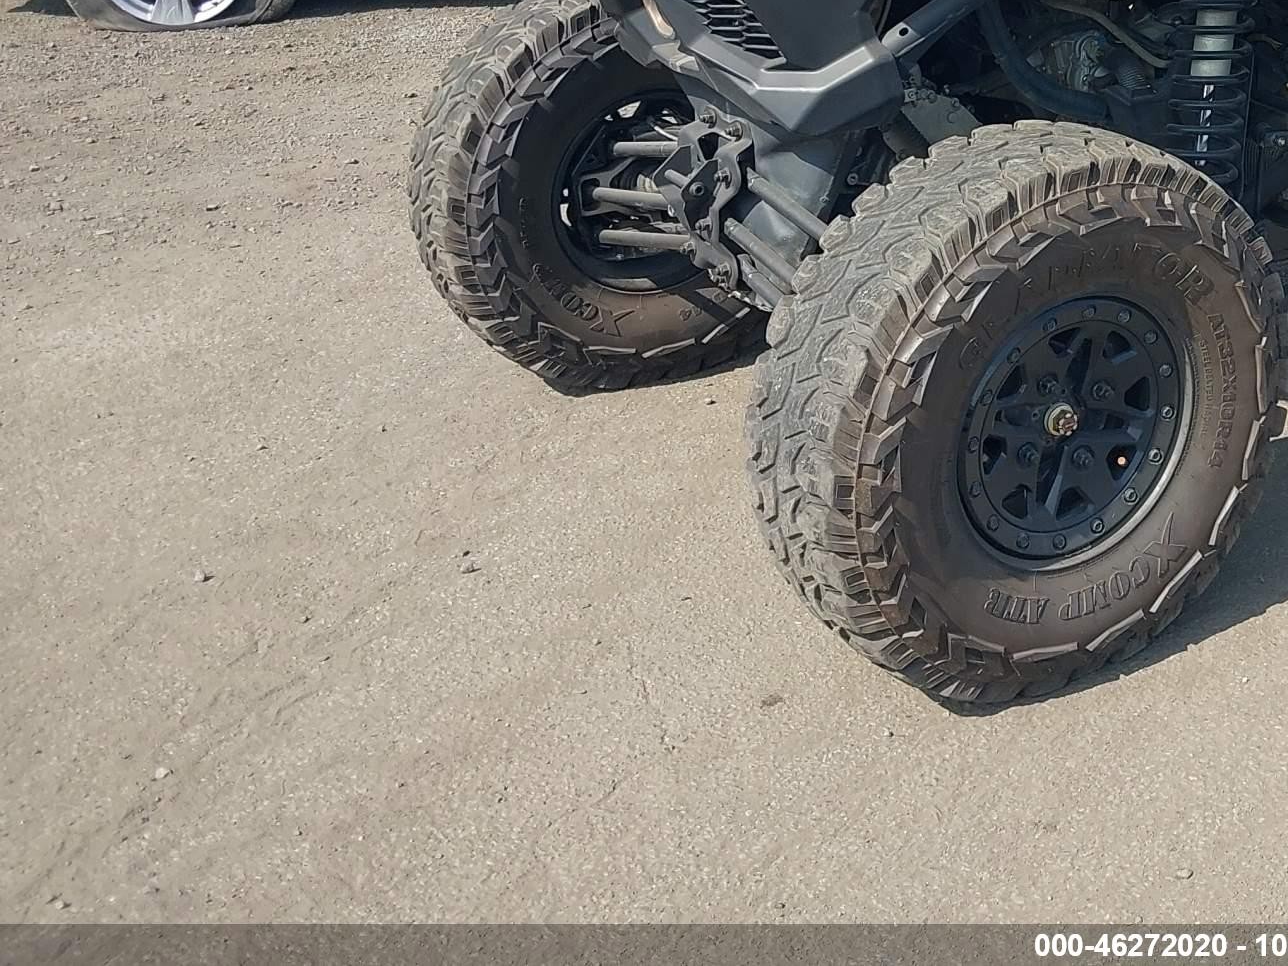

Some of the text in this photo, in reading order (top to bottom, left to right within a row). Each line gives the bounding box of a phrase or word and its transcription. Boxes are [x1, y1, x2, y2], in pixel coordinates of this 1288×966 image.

[1199, 339, 1212, 367] STEEL
[1207, 313, 1237, 468] AT32X10R14
[984, 587, 1049, 624] ATR
